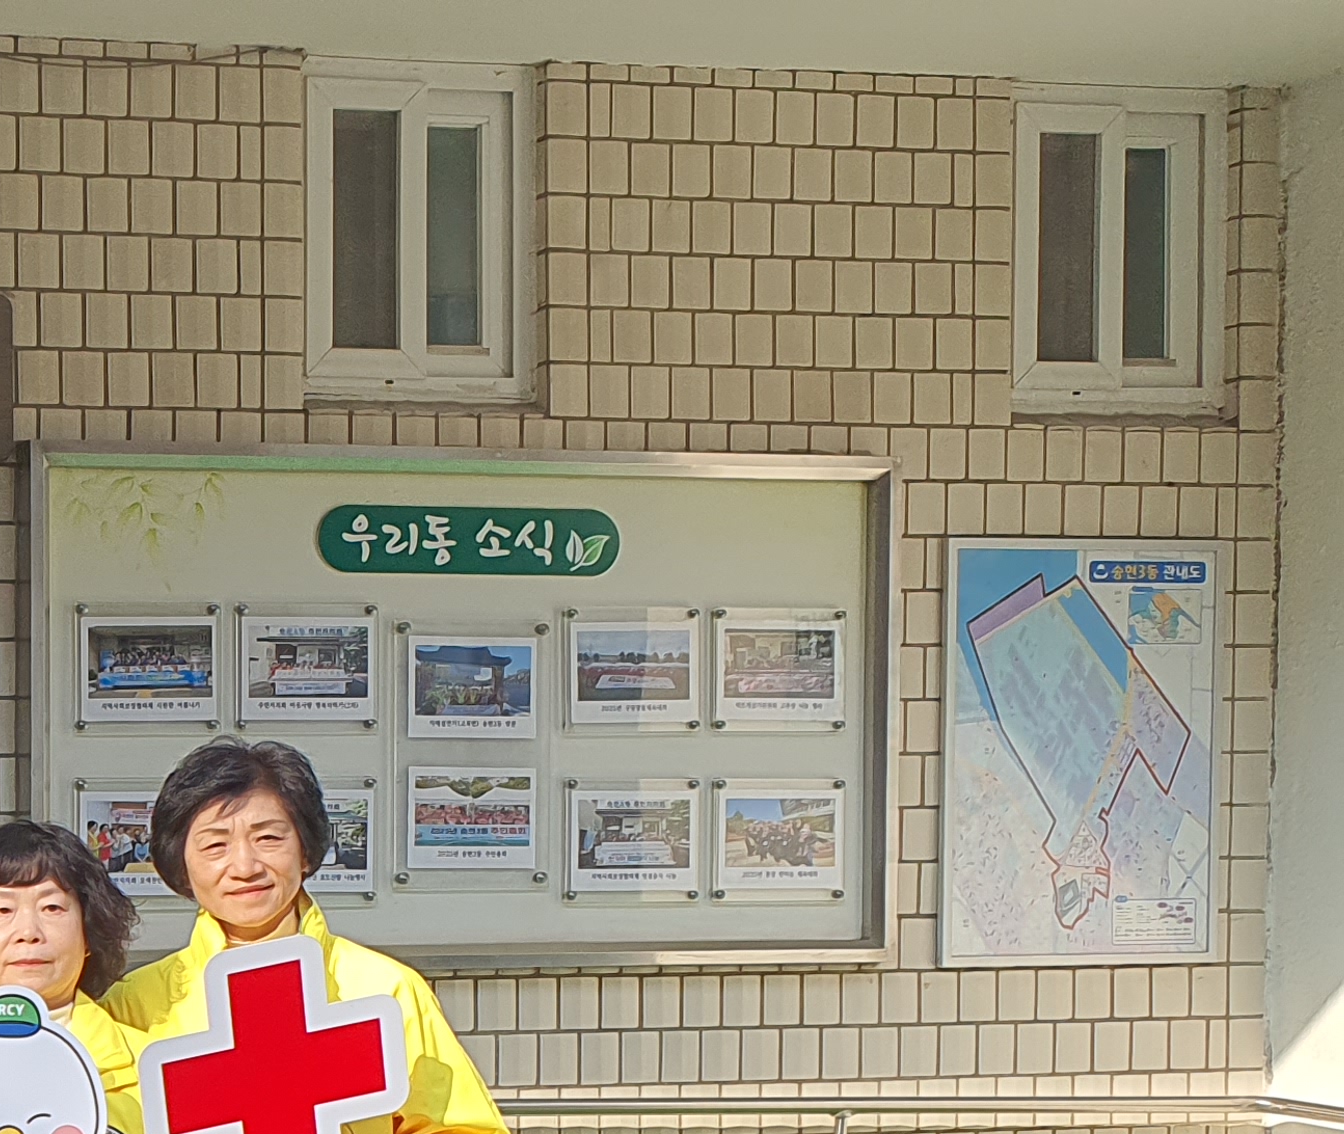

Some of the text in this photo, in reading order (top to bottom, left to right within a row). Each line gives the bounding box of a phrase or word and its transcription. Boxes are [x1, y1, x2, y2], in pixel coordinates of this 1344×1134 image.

[341, 513, 554, 566] 우리동 소식
[1112, 564, 1202, 580] 송현3동 관내도
